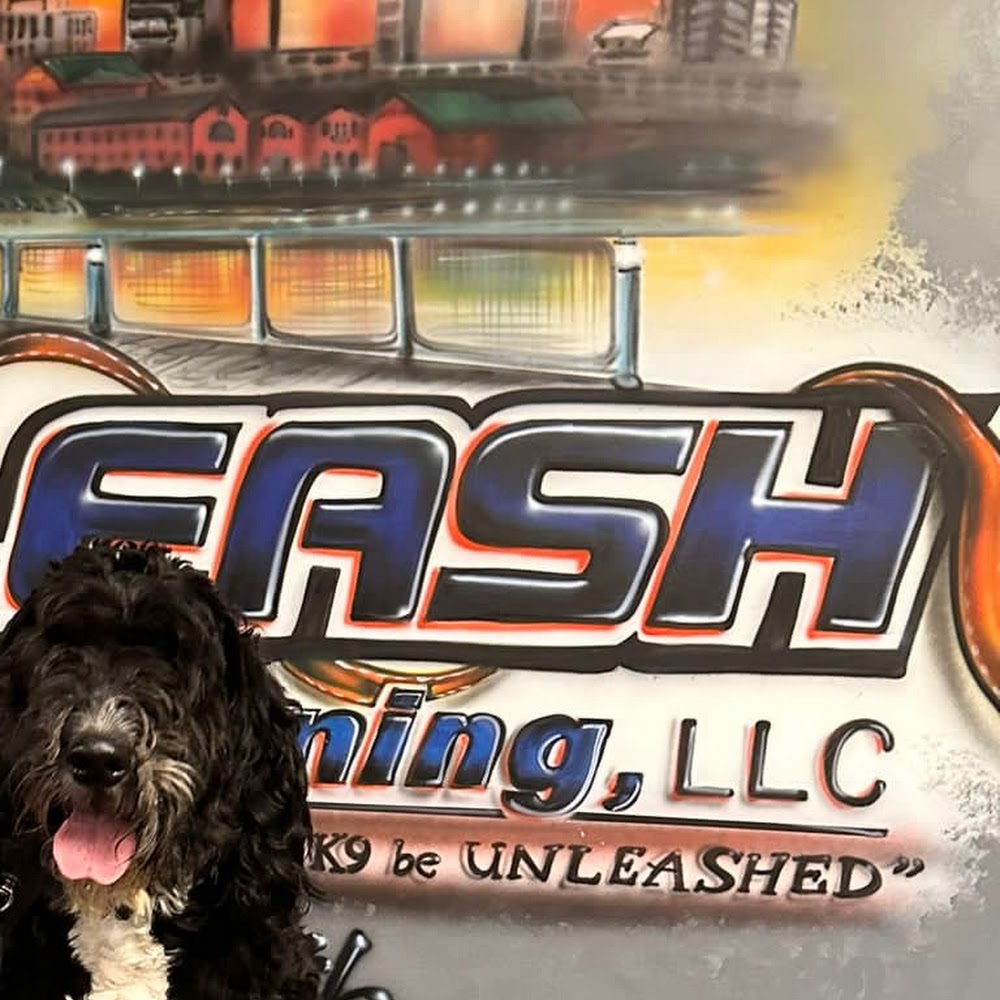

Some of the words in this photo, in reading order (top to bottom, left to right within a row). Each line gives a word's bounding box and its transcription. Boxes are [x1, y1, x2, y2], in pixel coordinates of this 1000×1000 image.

[298, 686, 645, 820] ning,
[674, 717, 896, 809] LLC
[311, 832, 372, 875] K9
[392, 838, 442, 880] be
